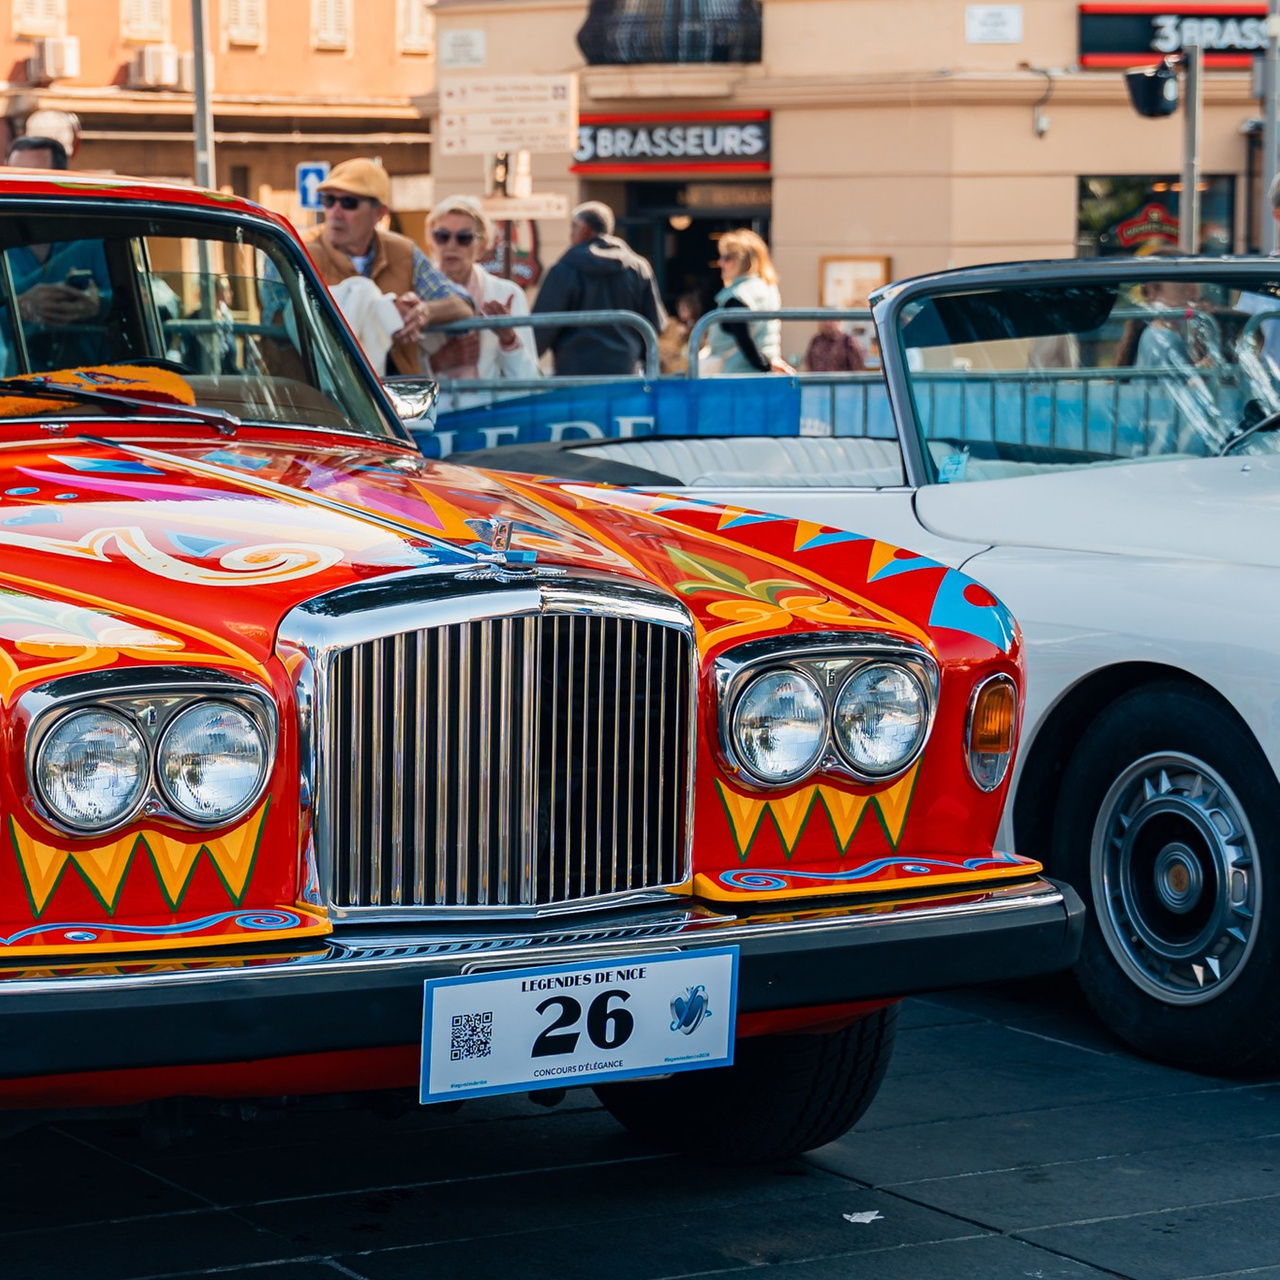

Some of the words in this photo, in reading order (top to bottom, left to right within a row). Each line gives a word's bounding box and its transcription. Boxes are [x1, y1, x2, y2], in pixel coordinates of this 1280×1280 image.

[521, 973, 592, 992] LEGENDES
[595, 970, 613, 984] DE
[616, 967, 647, 981] NICE
[530, 989, 634, 1058] 26
[533, 1065, 577, 1077] CONCOURS
[578, 1059, 624, 1072] D'ÉLÉGANCE
